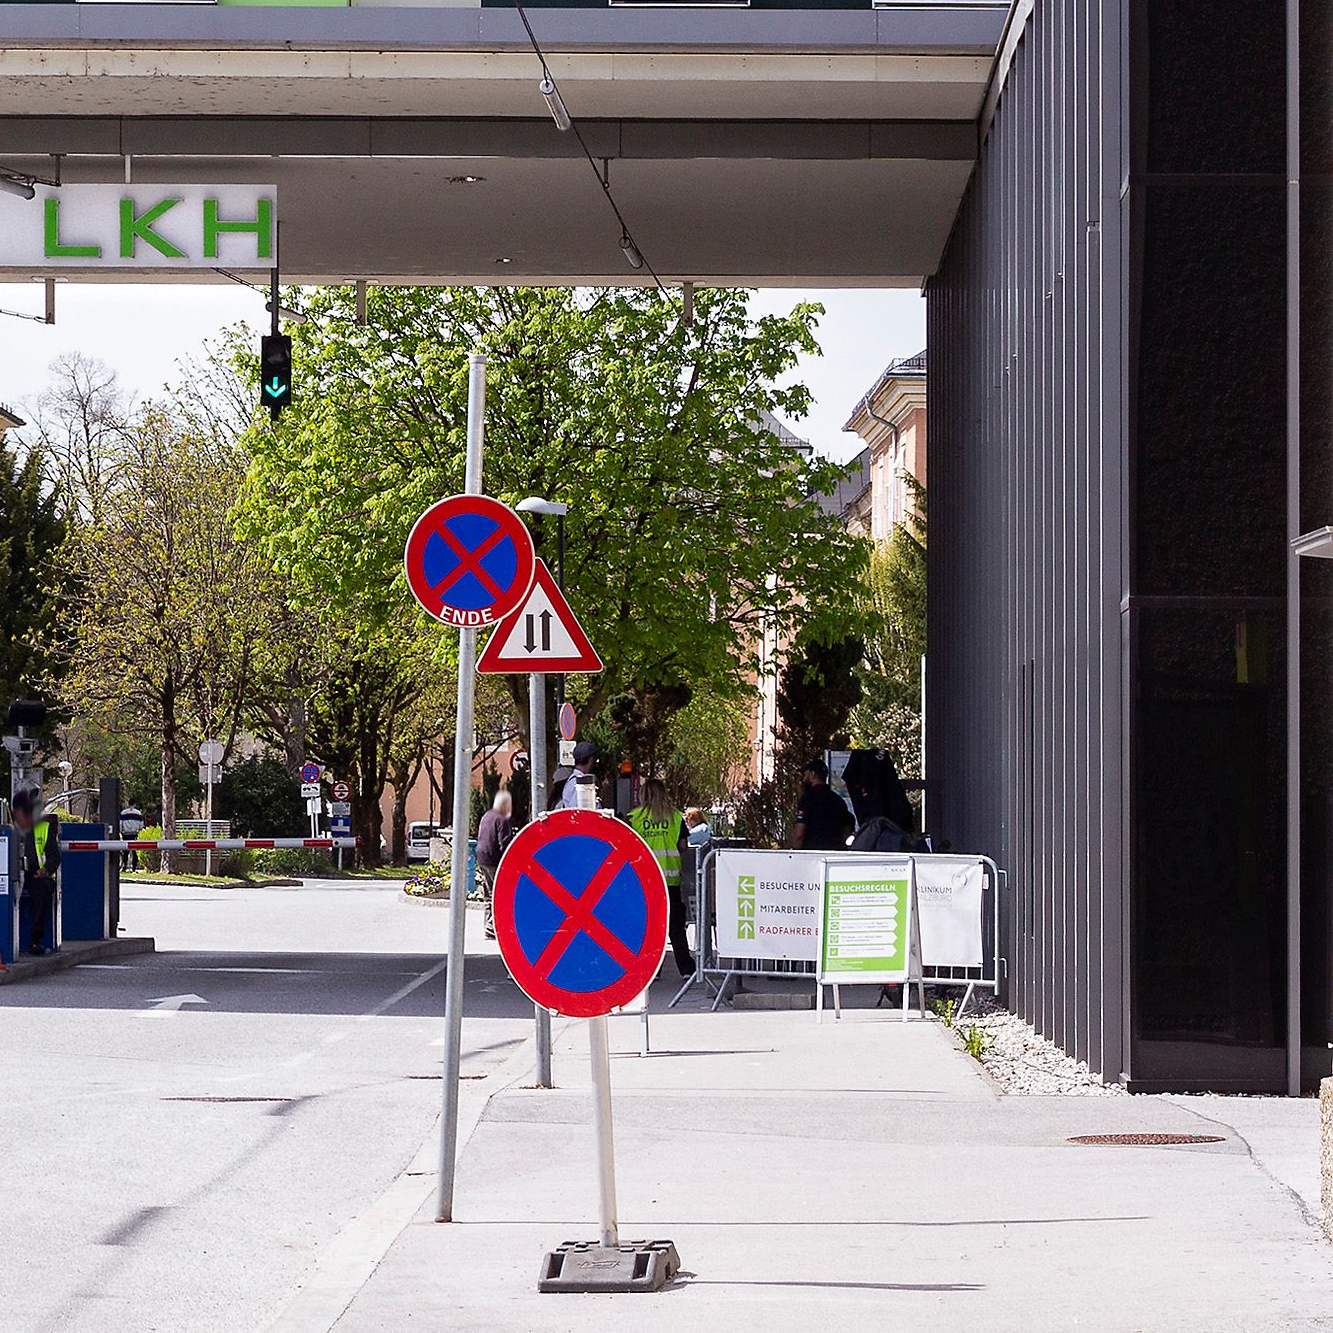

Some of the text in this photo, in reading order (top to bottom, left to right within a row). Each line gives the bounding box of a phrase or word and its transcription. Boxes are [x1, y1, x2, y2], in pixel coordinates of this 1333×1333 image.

[44, 196, 274, 260] LKH
[439, 605, 494, 625] ENDE
[759, 881, 821, 891] BESUCHER UN
[828, 883, 896, 892] BESUCHSREGELN
[760, 905, 816, 915] MITARBEITER
[758, 926, 813, 936] RADFAHRER
